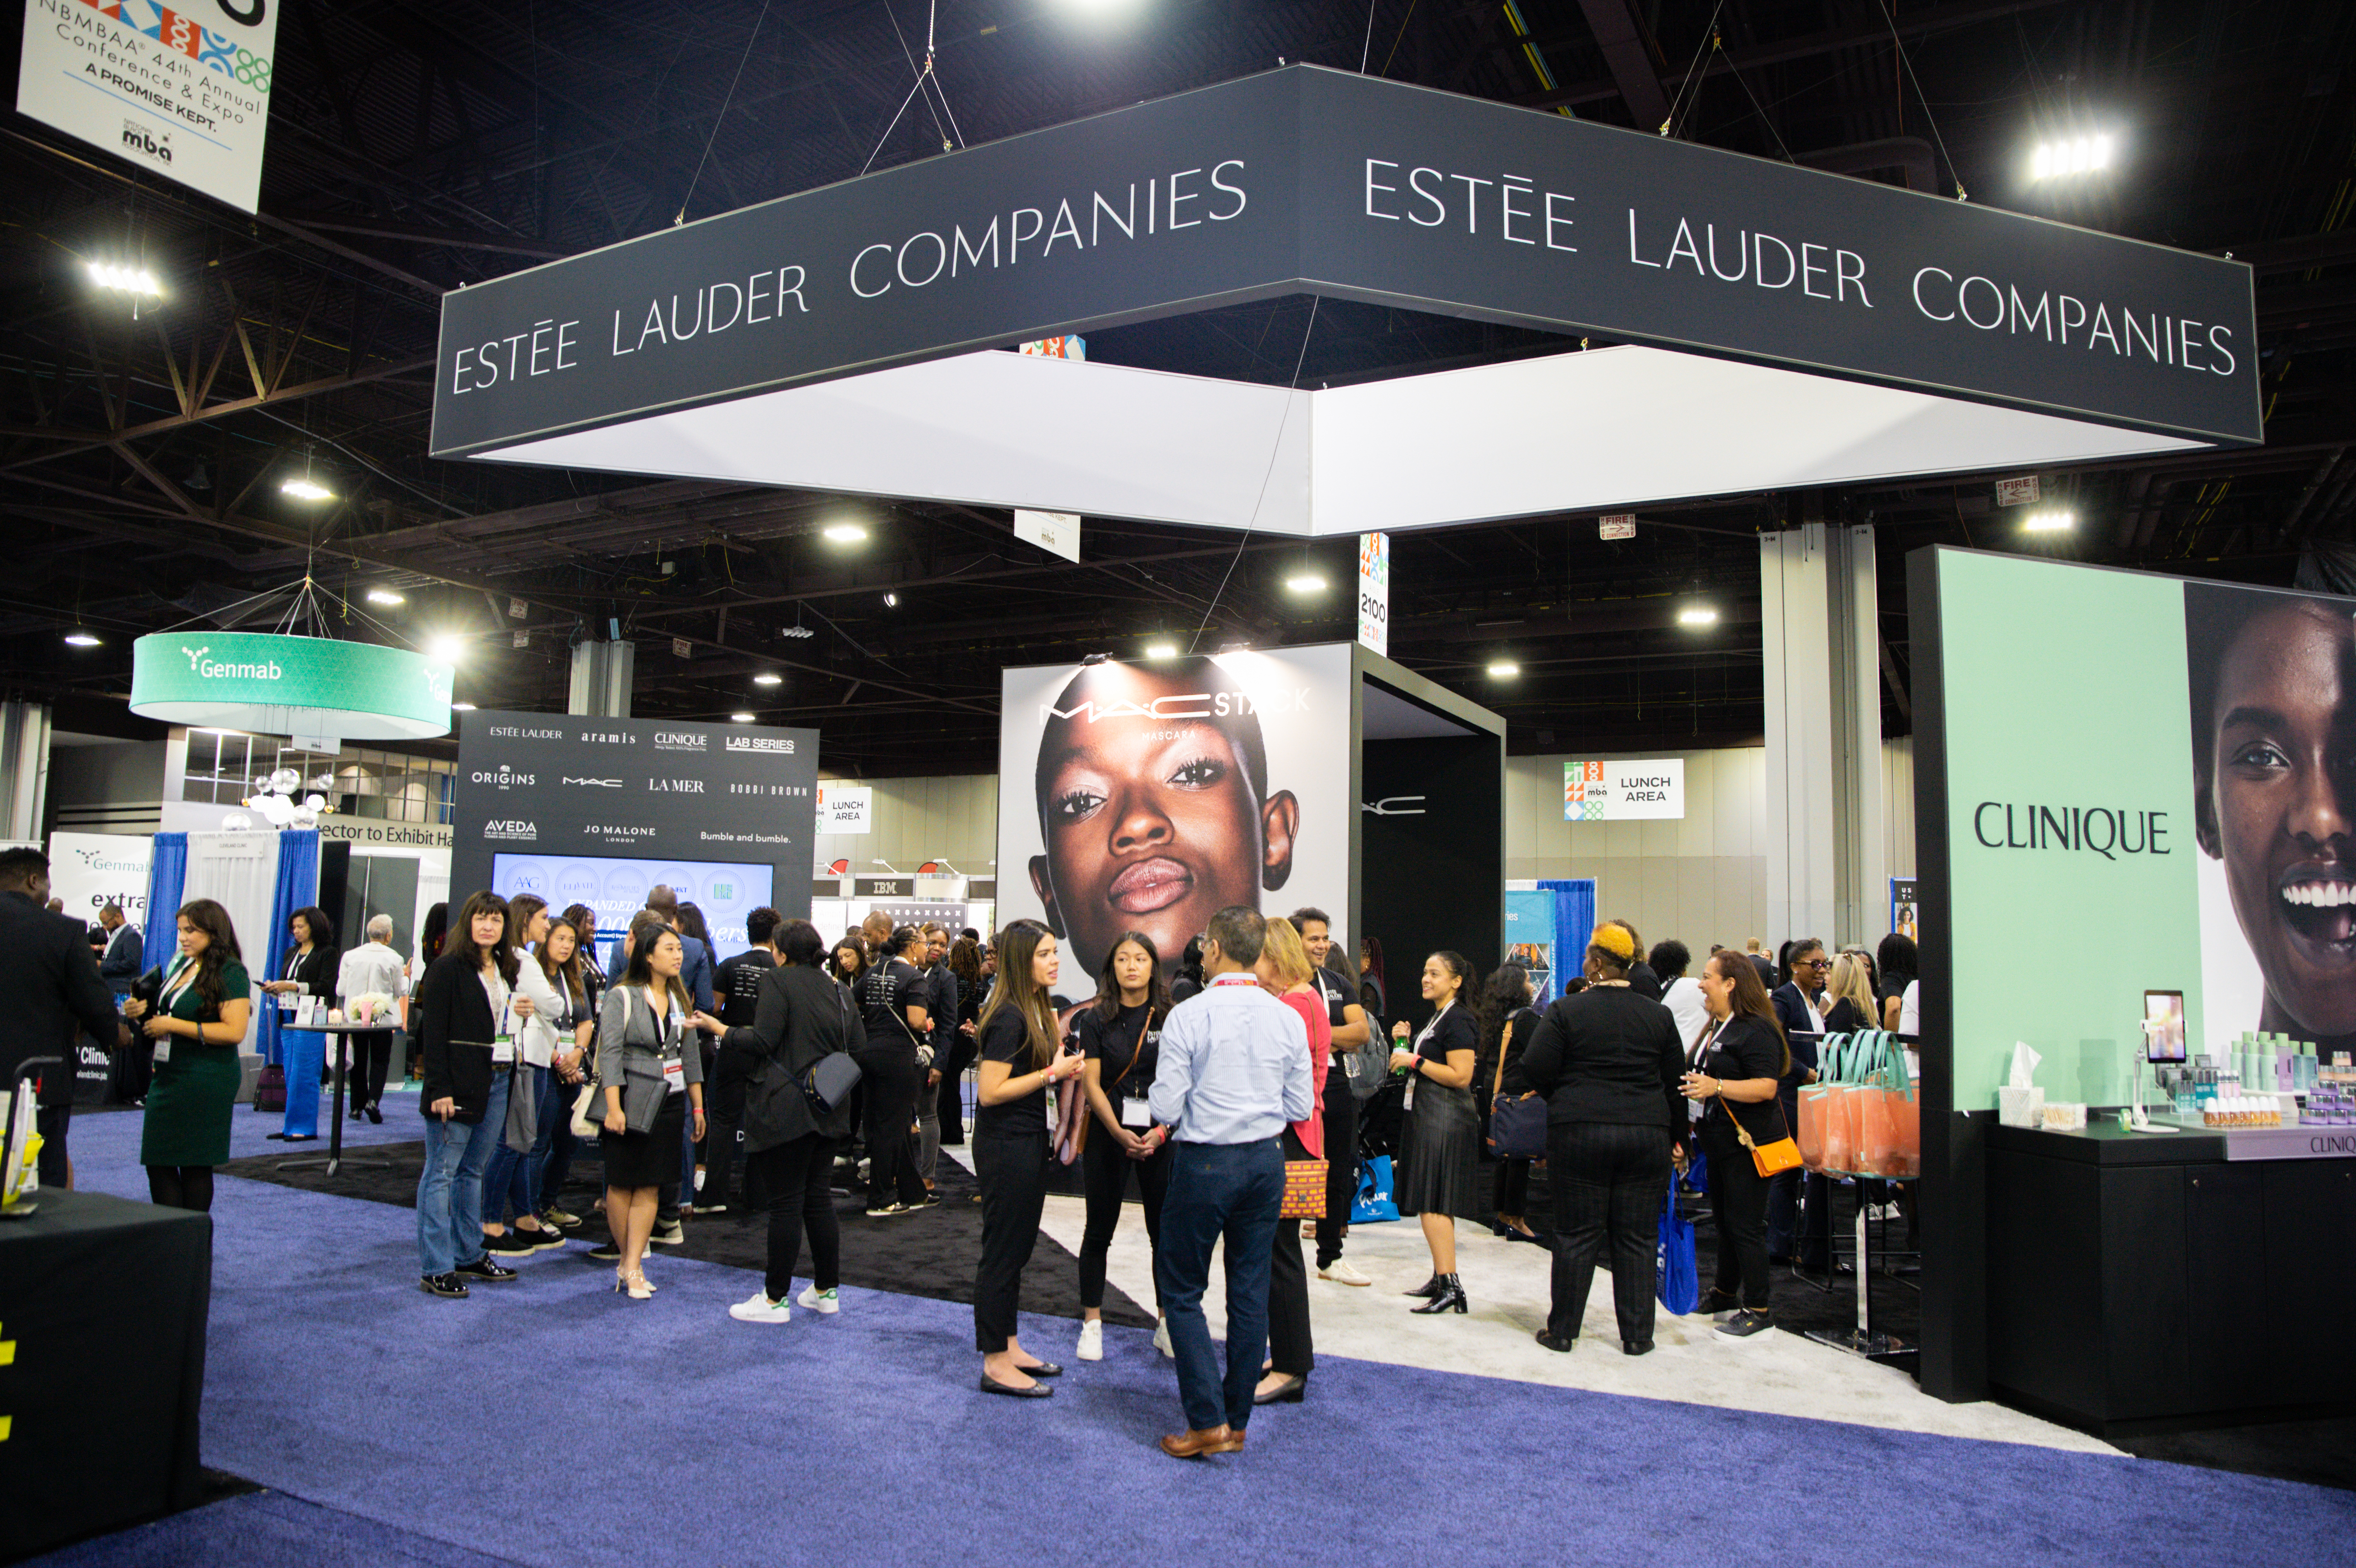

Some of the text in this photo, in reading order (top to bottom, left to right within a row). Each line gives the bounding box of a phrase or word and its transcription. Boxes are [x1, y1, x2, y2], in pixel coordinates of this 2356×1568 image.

[57, 24, 243, 123] Conference & Expo
[152, 54, 191, 77] 44th
[199, 76, 260, 114] Annual
[86, 63, 217, 132] A PROMISE KEPT.
[123, 130, 172, 162] mba
[613, 265, 810, 356] LAUDER
[851, 160, 1246, 297] COMPANIES
[1629, 208, 1874, 307] LAUDER
[1913, 267, 2236, 375] COMPANIES
[2004, 479, 2030, 490] FIRE
[2005, 496, 2032, 505] CONNECTION
[1606, 516, 1628, 524] FIRE
[1041, 533, 1055, 544] mba
[1362, 593, 1385, 623] 2100
[201, 659, 281, 680] Genmab
[1214, 687, 1312, 716] STACK
[522, 729, 562, 739] LAUDER
[582, 732, 636, 744] aramis
[655, 733, 707, 746] CLINIQUE
[1142, 730, 1196, 741] MASCARA
[726, 737, 795, 750] LAB SERIES
[472, 772, 535, 785] ORIGINS
[1621, 777, 1670, 788] LUNCH
[649, 778, 705, 793] LA MER
[731, 784, 807, 796] BOBBI BROWN
[1625, 791, 1666, 801] AREA
[833, 801, 863, 809] LUNCH
[835, 812, 860, 820] AREA
[485, 820, 537, 833] AVEDA
[604, 826, 655, 836] MALONE
[1974, 801, 2171, 860] CLINIQUE
[367, 827, 382, 840] to
[387, 827, 434, 845] Exhibit
[701, 832, 791, 843] Bumble and bumble.
[874, 882, 896, 894] IBM
[567, 899, 636, 911] EXPANDED
